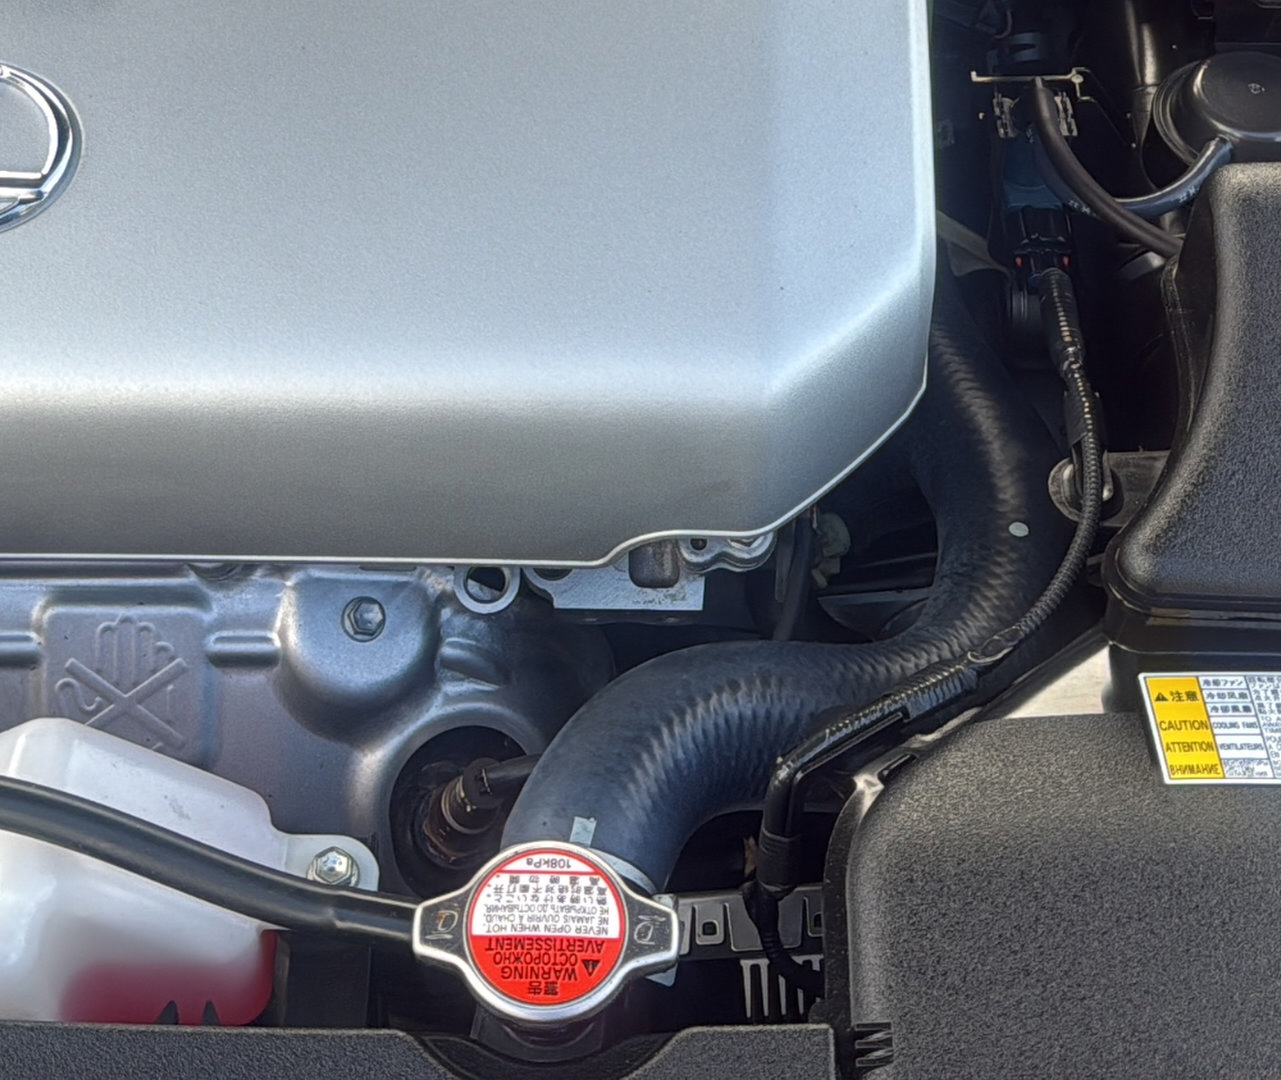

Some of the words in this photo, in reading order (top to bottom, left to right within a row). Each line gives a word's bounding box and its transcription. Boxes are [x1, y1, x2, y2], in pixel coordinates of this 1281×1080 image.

[1171, 690, 1200, 702] 注意
[1159, 720, 1209, 731] CAUTION
[1213, 722, 1240, 730] COOLING
[1242, 722, 1259, 730] FANS
[1165, 741, 1215, 753] ATTENTION
[1219, 743, 1265, 751] VENTILATEURS
[1169, 763, 1221, 776] ВНИМАНИЕ
[526, 857, 572, 869] 108kPa
[599, 906, 609, 915] НЕ
[527, 914, 561, 924] OUVRIR
[563, 915, 596, 925] JAMAIS
[597, 917, 609, 925] NE
[483, 922, 507, 933] HOT.
[510, 923, 542, 933] WHEN
[544, 924, 573, 934] OPEN
[575, 925, 609, 935] NEVER
[484, 937, 605, 952] AVERTISSEMENT
[493, 951, 578, 965] ОСТОРОЖНО
[500, 966, 578, 981] WARNING
[527, 981, 559, 996] 警告
